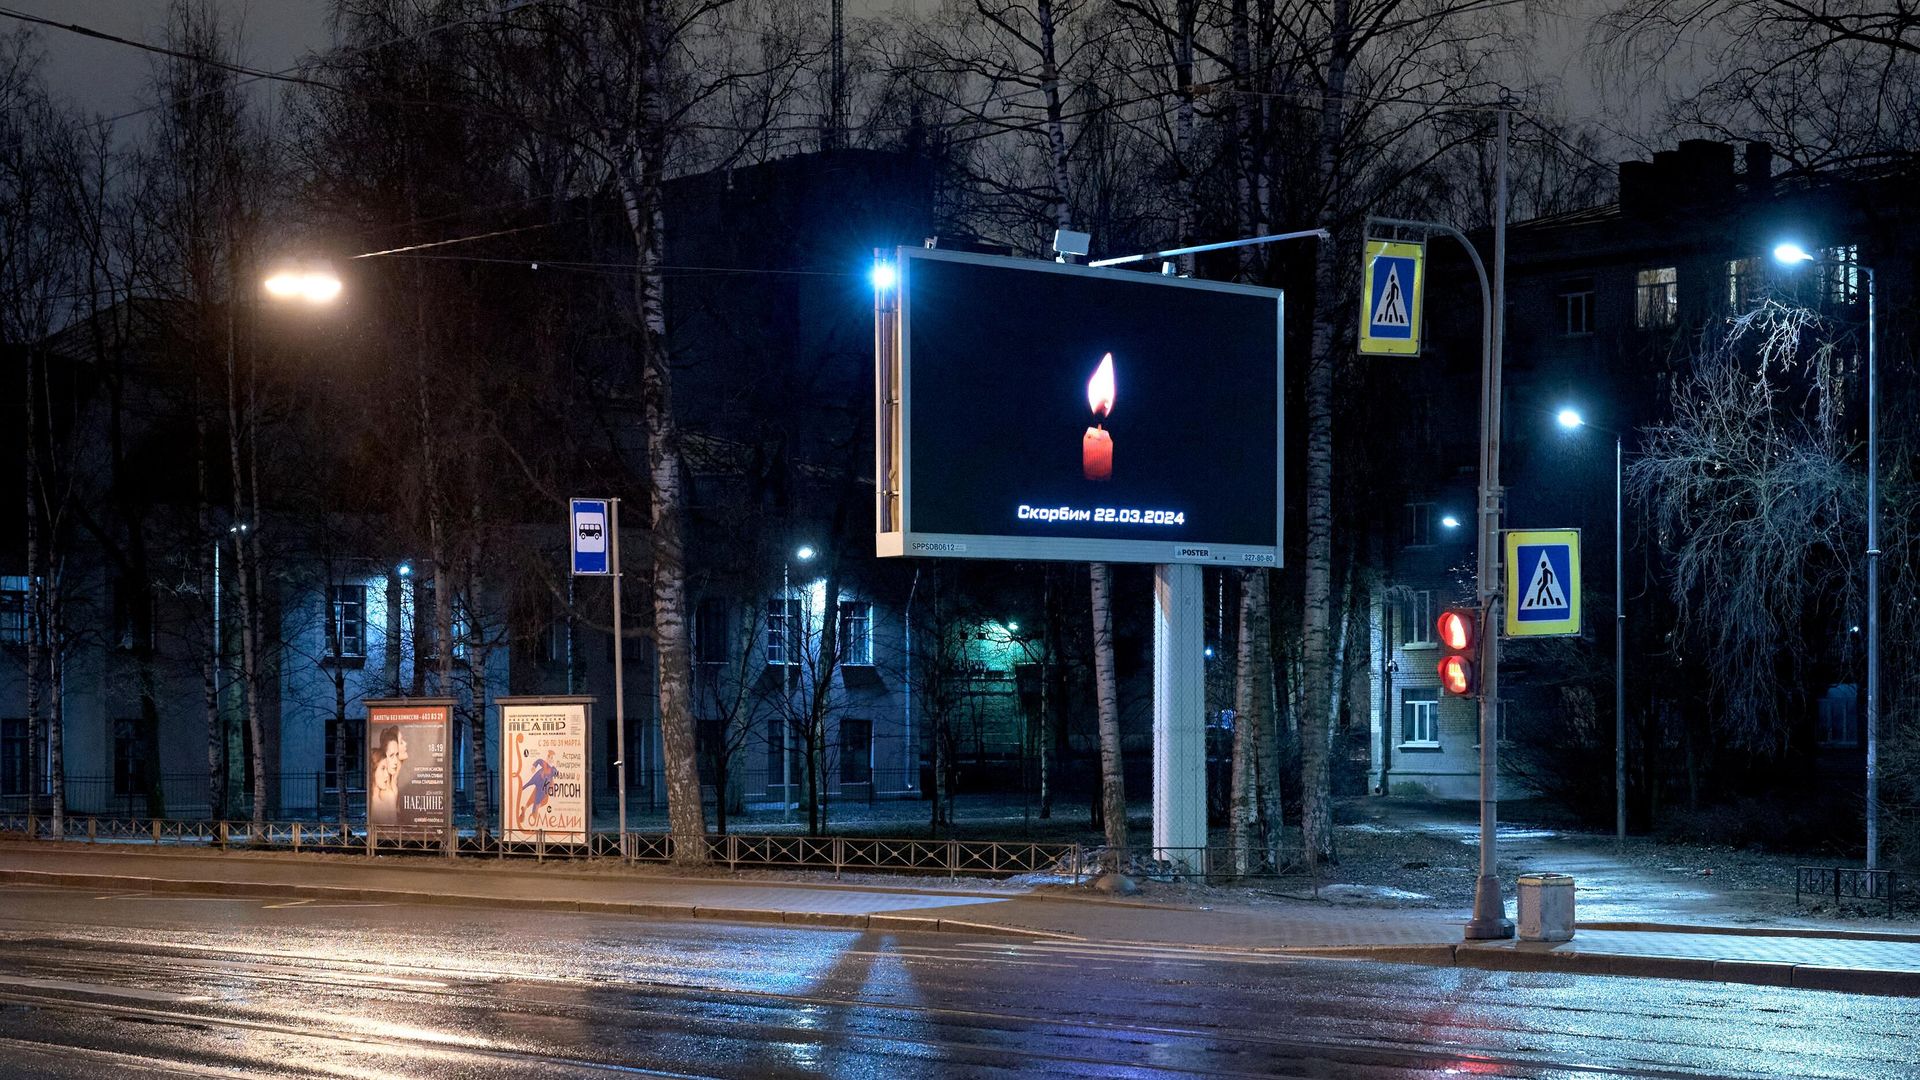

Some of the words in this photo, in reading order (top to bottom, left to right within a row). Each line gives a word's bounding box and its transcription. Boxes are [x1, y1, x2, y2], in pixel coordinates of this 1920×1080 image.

[1017, 505, 1091, 522] Скорбим
[1094, 508, 1185, 525] 22.03.2024
[1182, 549, 1209, 557] POSTER
[563, 739, 582, 748] МАРТА
[562, 752, 581, 761] Астрид
[553, 771, 576, 780] Малыш
[403, 795, 444, 811] НАЕДИНЕ
